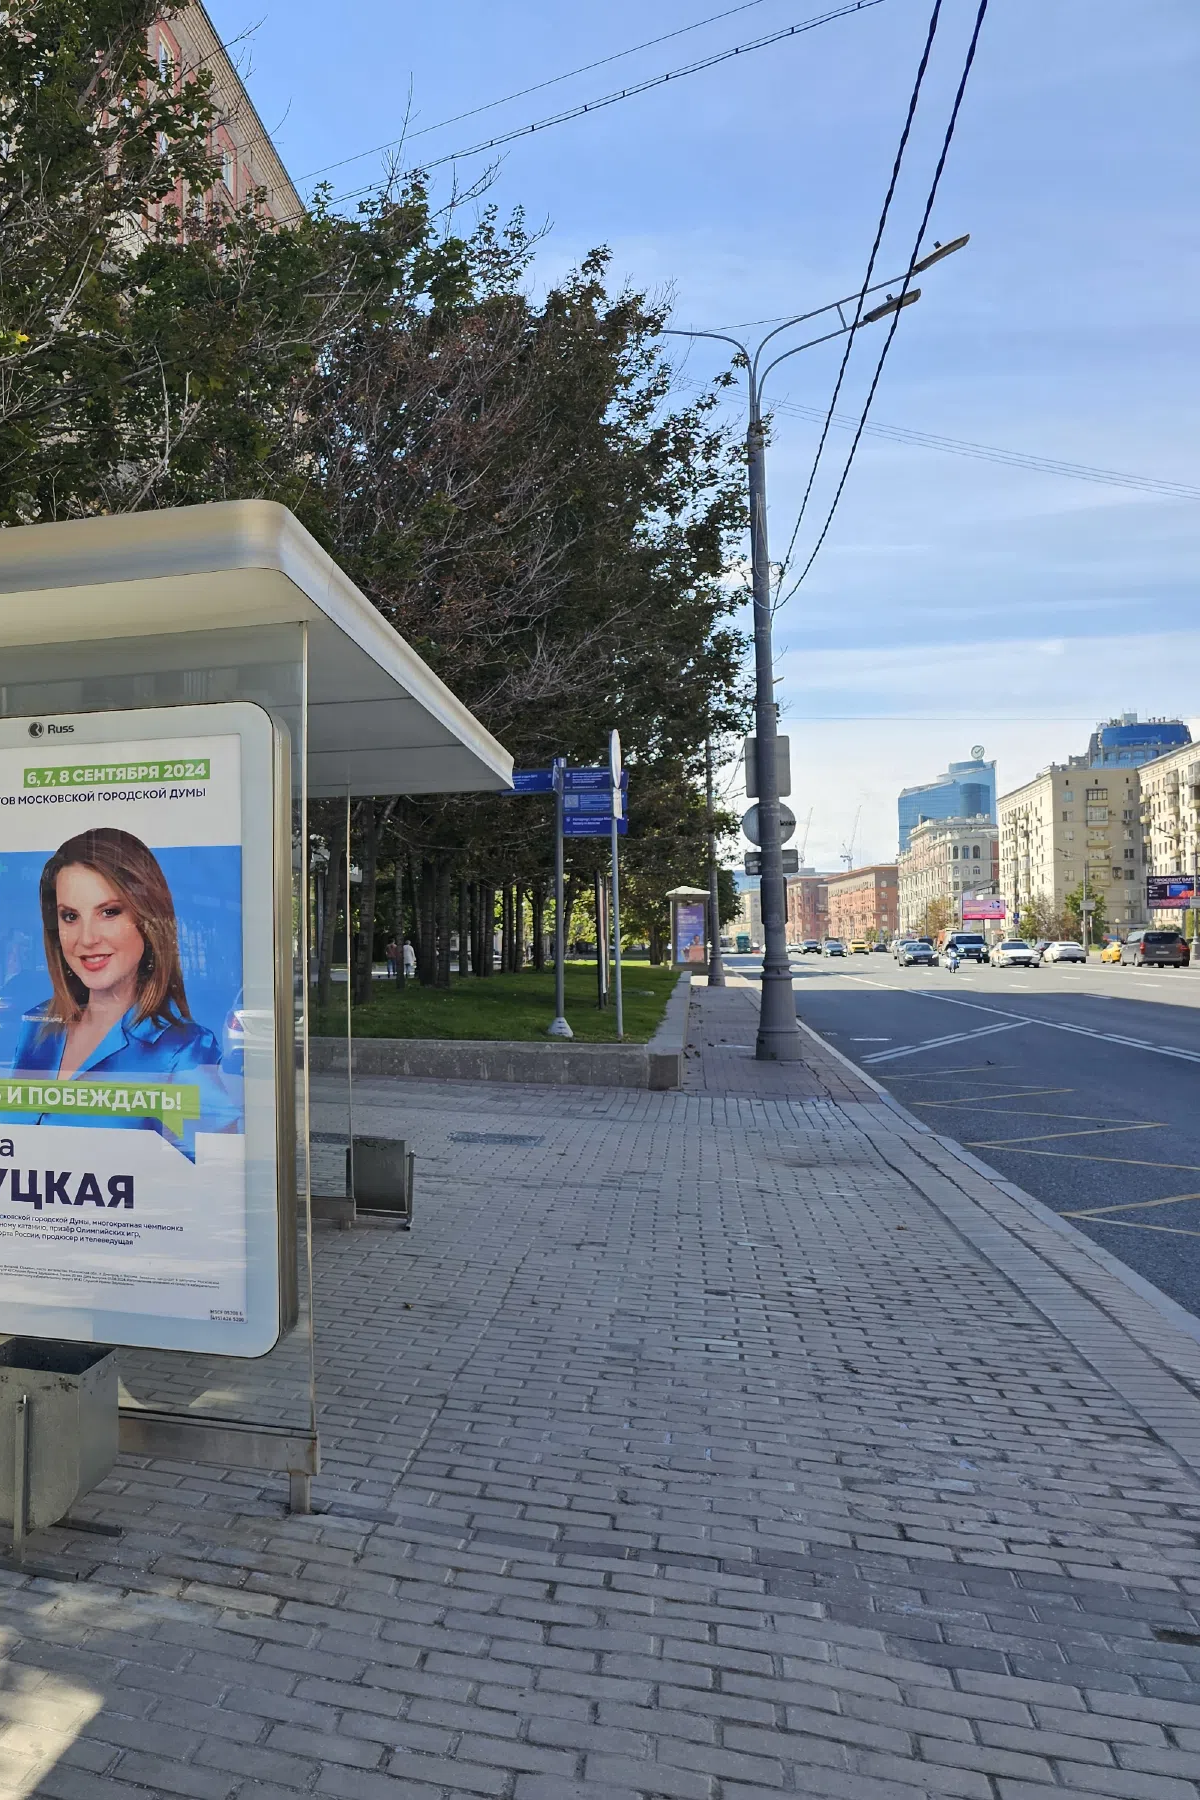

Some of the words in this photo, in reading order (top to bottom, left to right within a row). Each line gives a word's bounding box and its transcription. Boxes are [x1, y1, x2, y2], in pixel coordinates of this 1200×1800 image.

[47, 722, 75, 735] Russ
[27, 771, 41, 786] 6,
[44, 770, 56, 786] 7,
[59, 770, 70, 783] 8
[72, 764, 159, 782] СЕНТЯБРЯ
[163, 762, 206, 778] 2024
[18, 791, 95, 805] МОСКОВСКОЙ
[97, 787, 167, 801] ГОРОДСКОЙ
[169, 787, 206, 800] ДУМЫ
[7, 1086, 23, 1105] И
[28, 1086, 182, 1112] ПОБЕЖДАТЬ!
[32, 1216, 68, 1224] городской
[69, 1218, 91, 1226] Думы,
[92, 1220, 142, 1229] многократная
[144, 1224, 184, 1232] чемпионка
[50, 1226, 74, 1234] призёр
[76, 1227, 125, 1236] Олимпийских
[15, 1231, 41, 1239] России,
[42, 1234, 78, 1242] продюсер
[85, 1237, 134, 1246] телеведущая
